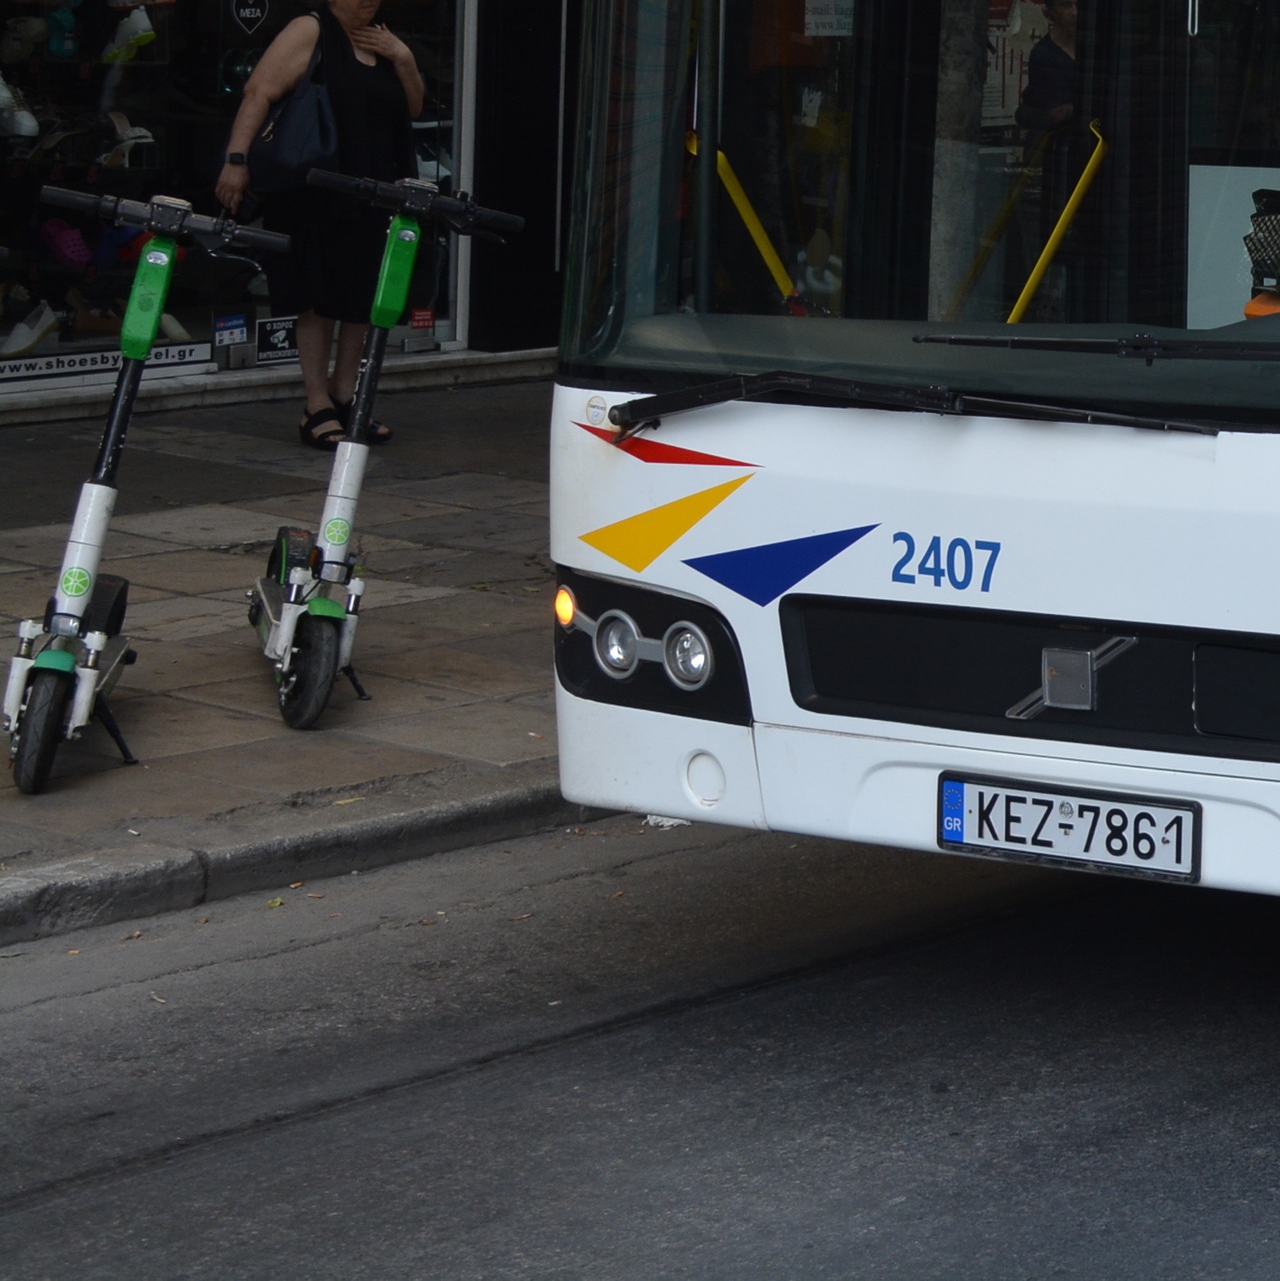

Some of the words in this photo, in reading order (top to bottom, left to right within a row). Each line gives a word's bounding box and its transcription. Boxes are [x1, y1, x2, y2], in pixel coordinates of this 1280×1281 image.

[239, 7, 262, 18] ΜΕΣΑ
[891, 530, 1002, 593] 2407
[943, 815, 962, 833] GR
[977, 790, 1184, 865] KEZ-7861
